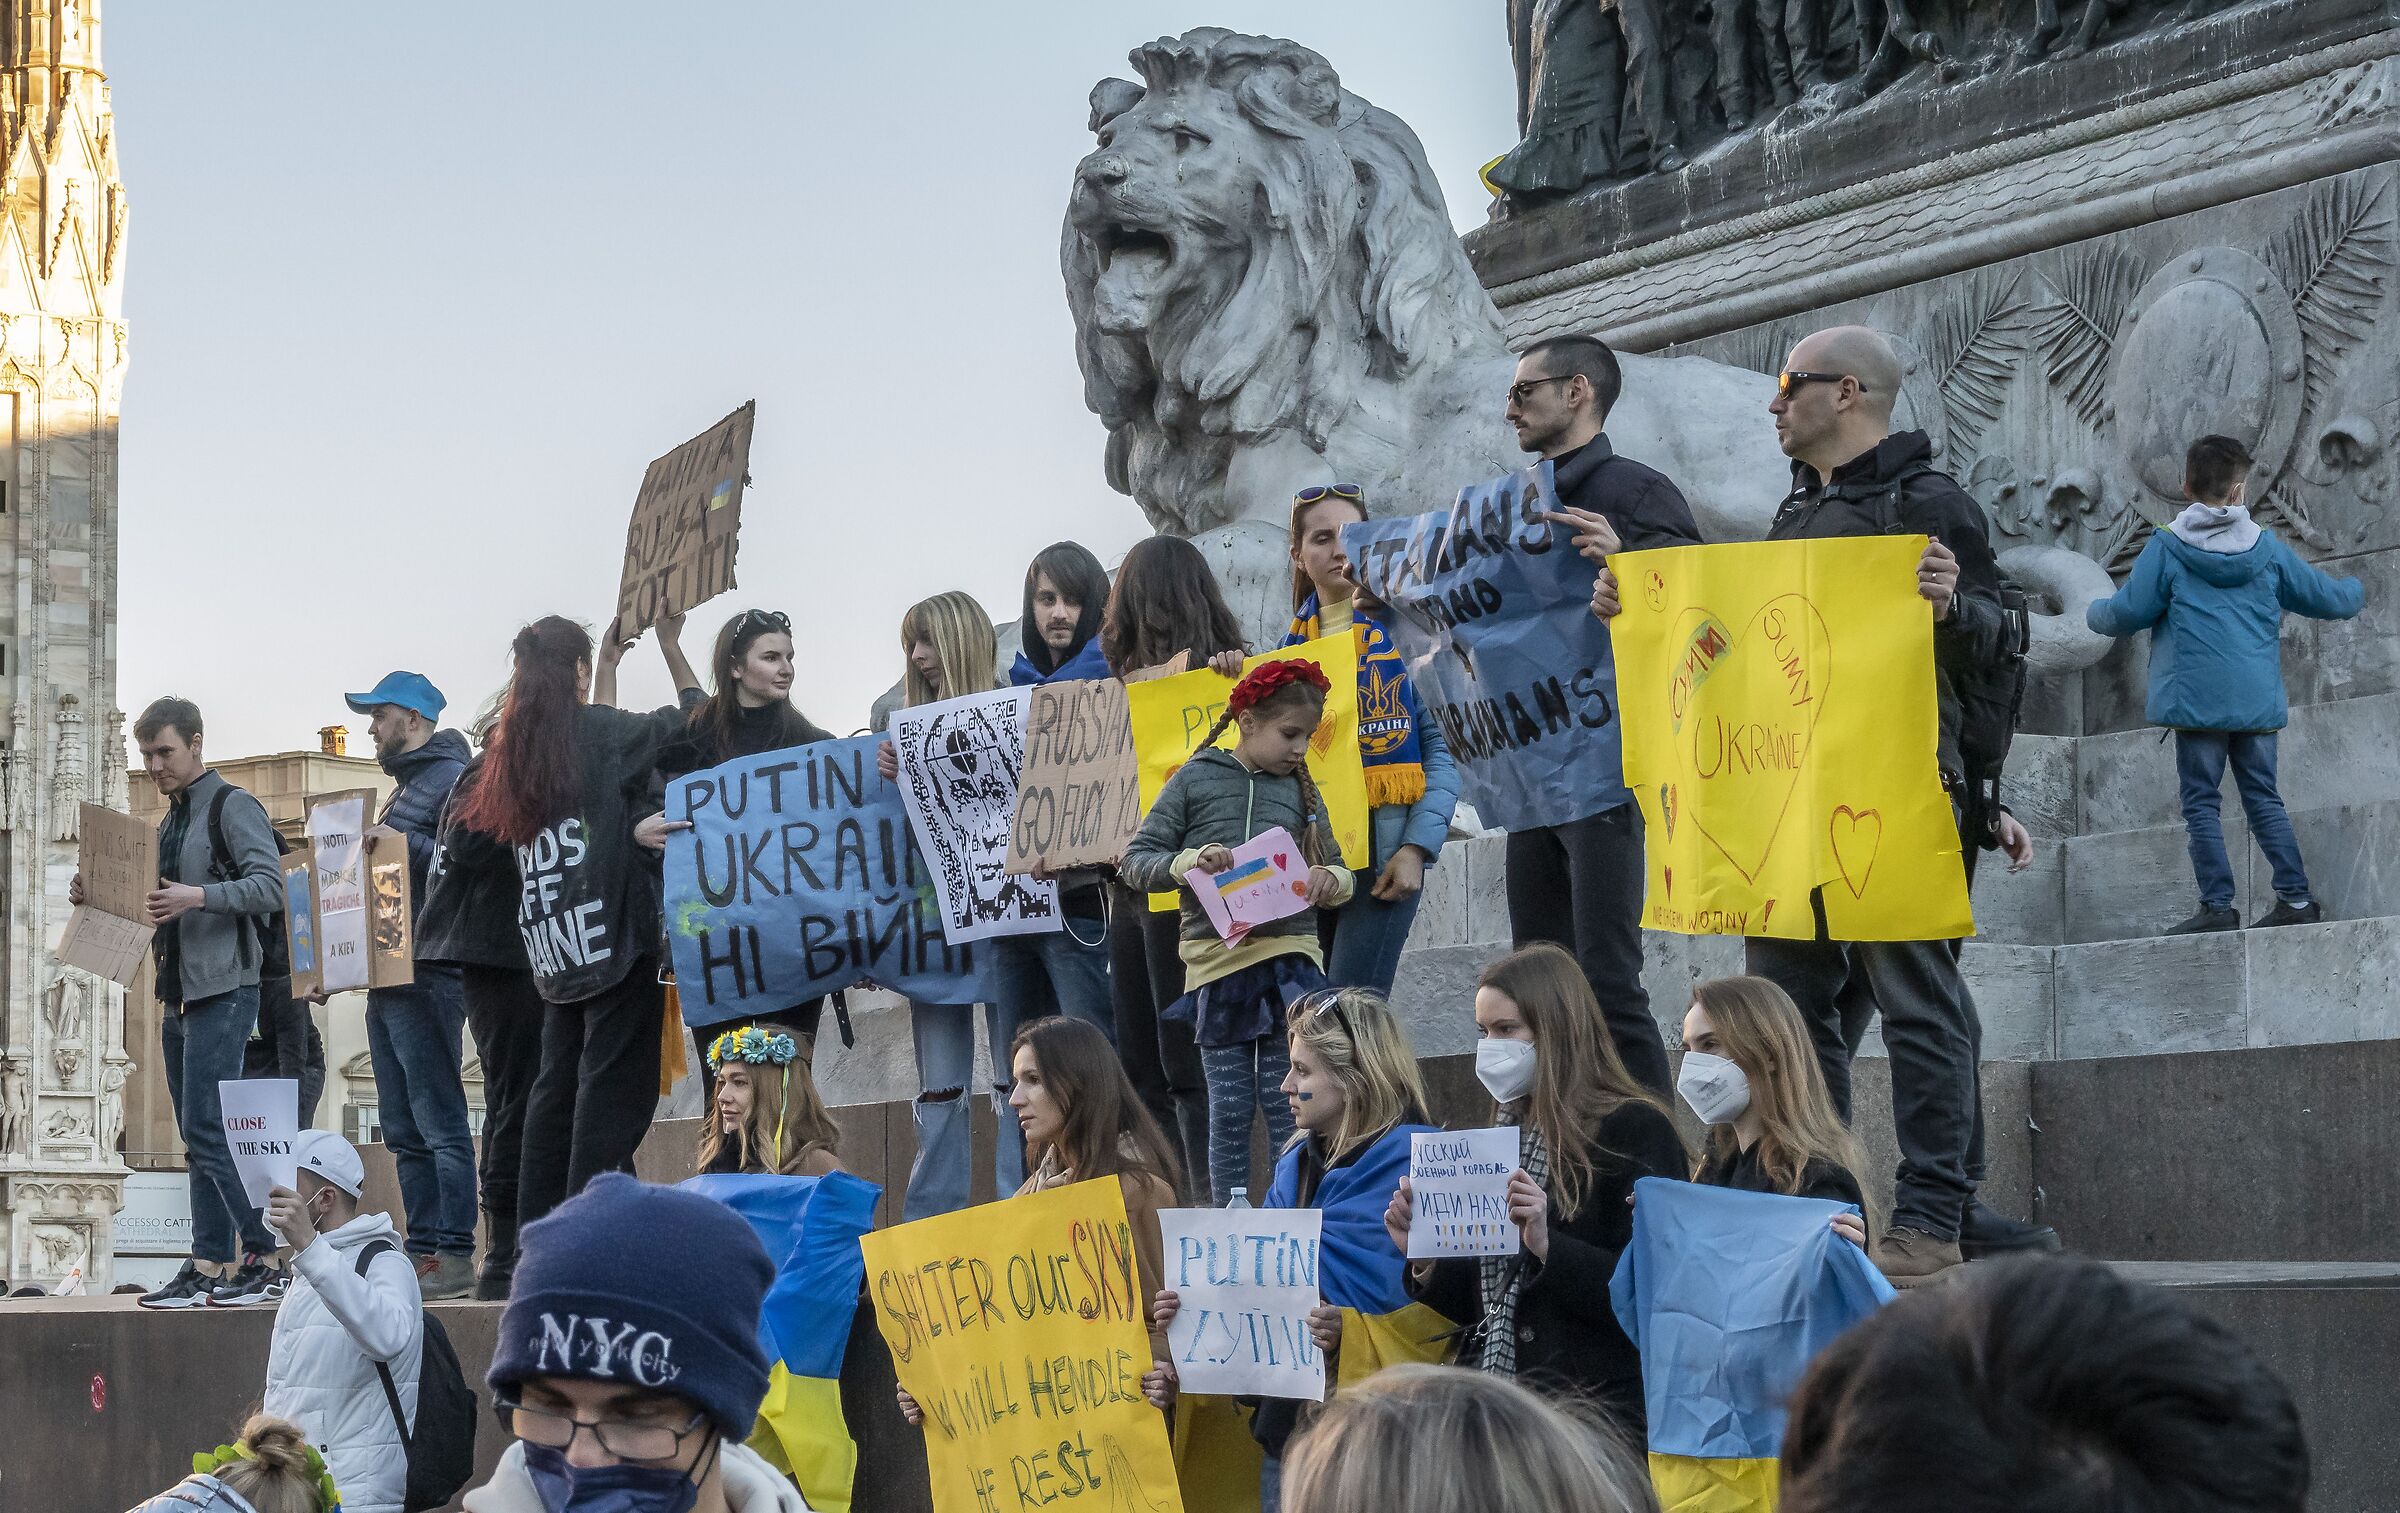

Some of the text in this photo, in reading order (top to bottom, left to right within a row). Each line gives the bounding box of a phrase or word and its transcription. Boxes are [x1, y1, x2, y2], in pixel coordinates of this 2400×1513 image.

[1763, 608, 1814, 707] SUMY
[1016, 785, 1056, 859] GO
[1056, 780, 1111, 851] FUCK
[322, 833, 348, 850] NOTTI
[322, 894, 360, 913] TRAGICHE
[519, 873, 563, 924] FF
[1688, 911, 1748, 935] WOJNY
[330, 941, 355, 957] A KIEV
[227, 1117, 266, 1131] CLOSE
[236, 1141, 293, 1155] THE SKY
[1463, 1163, 1510, 1175] КОРАБЛЬ
[1420, 1192, 1463, 1221] ИДИ
[113, 1217, 160, 1227] ACCESSO
[1070, 1217, 1135, 1324] SKY
[536, 1312, 673, 1387] NYC
[1025, 1348, 1143, 1420] HENDLE
